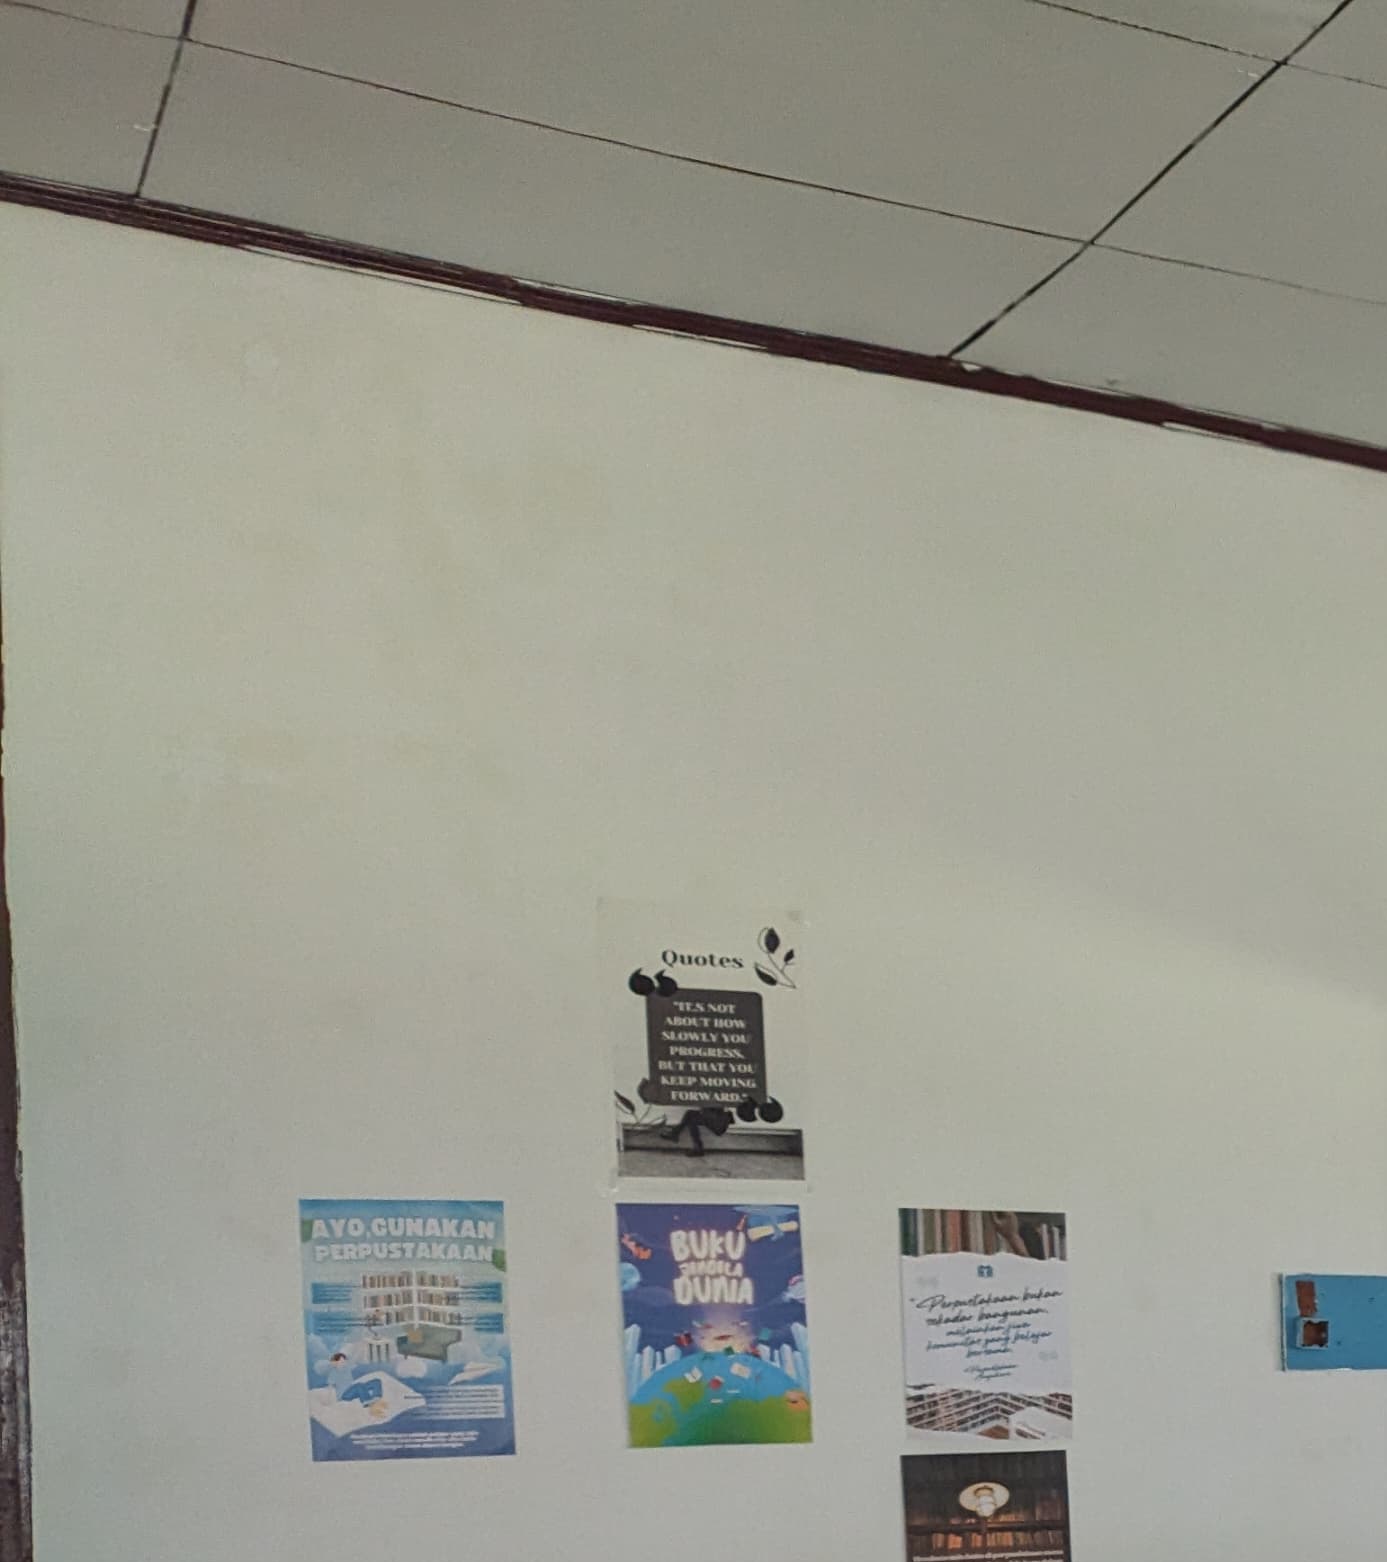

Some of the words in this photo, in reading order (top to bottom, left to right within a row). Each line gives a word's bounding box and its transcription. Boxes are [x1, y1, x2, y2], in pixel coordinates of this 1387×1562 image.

[661, 949, 744, 969] Quotes
[707, 1003, 736, 1014] NOT
[665, 1016, 710, 1028] ABOUT
[714, 1018, 746, 1029] HOW
[661, 1031, 718, 1042] SLOWLY
[721, 1033, 751, 1044] YOU
[658, 1060, 685, 1071] BUT
[689, 1062, 726, 1073] THAT
[728, 1063, 757, 1074] YOU
[661, 1075, 697, 1086] KEEP
[699, 1076, 756, 1088] MOVING
[314, 1242, 493, 1262] PERPUSTAKAAN
[673, 1276, 754, 1305] DUNIA
